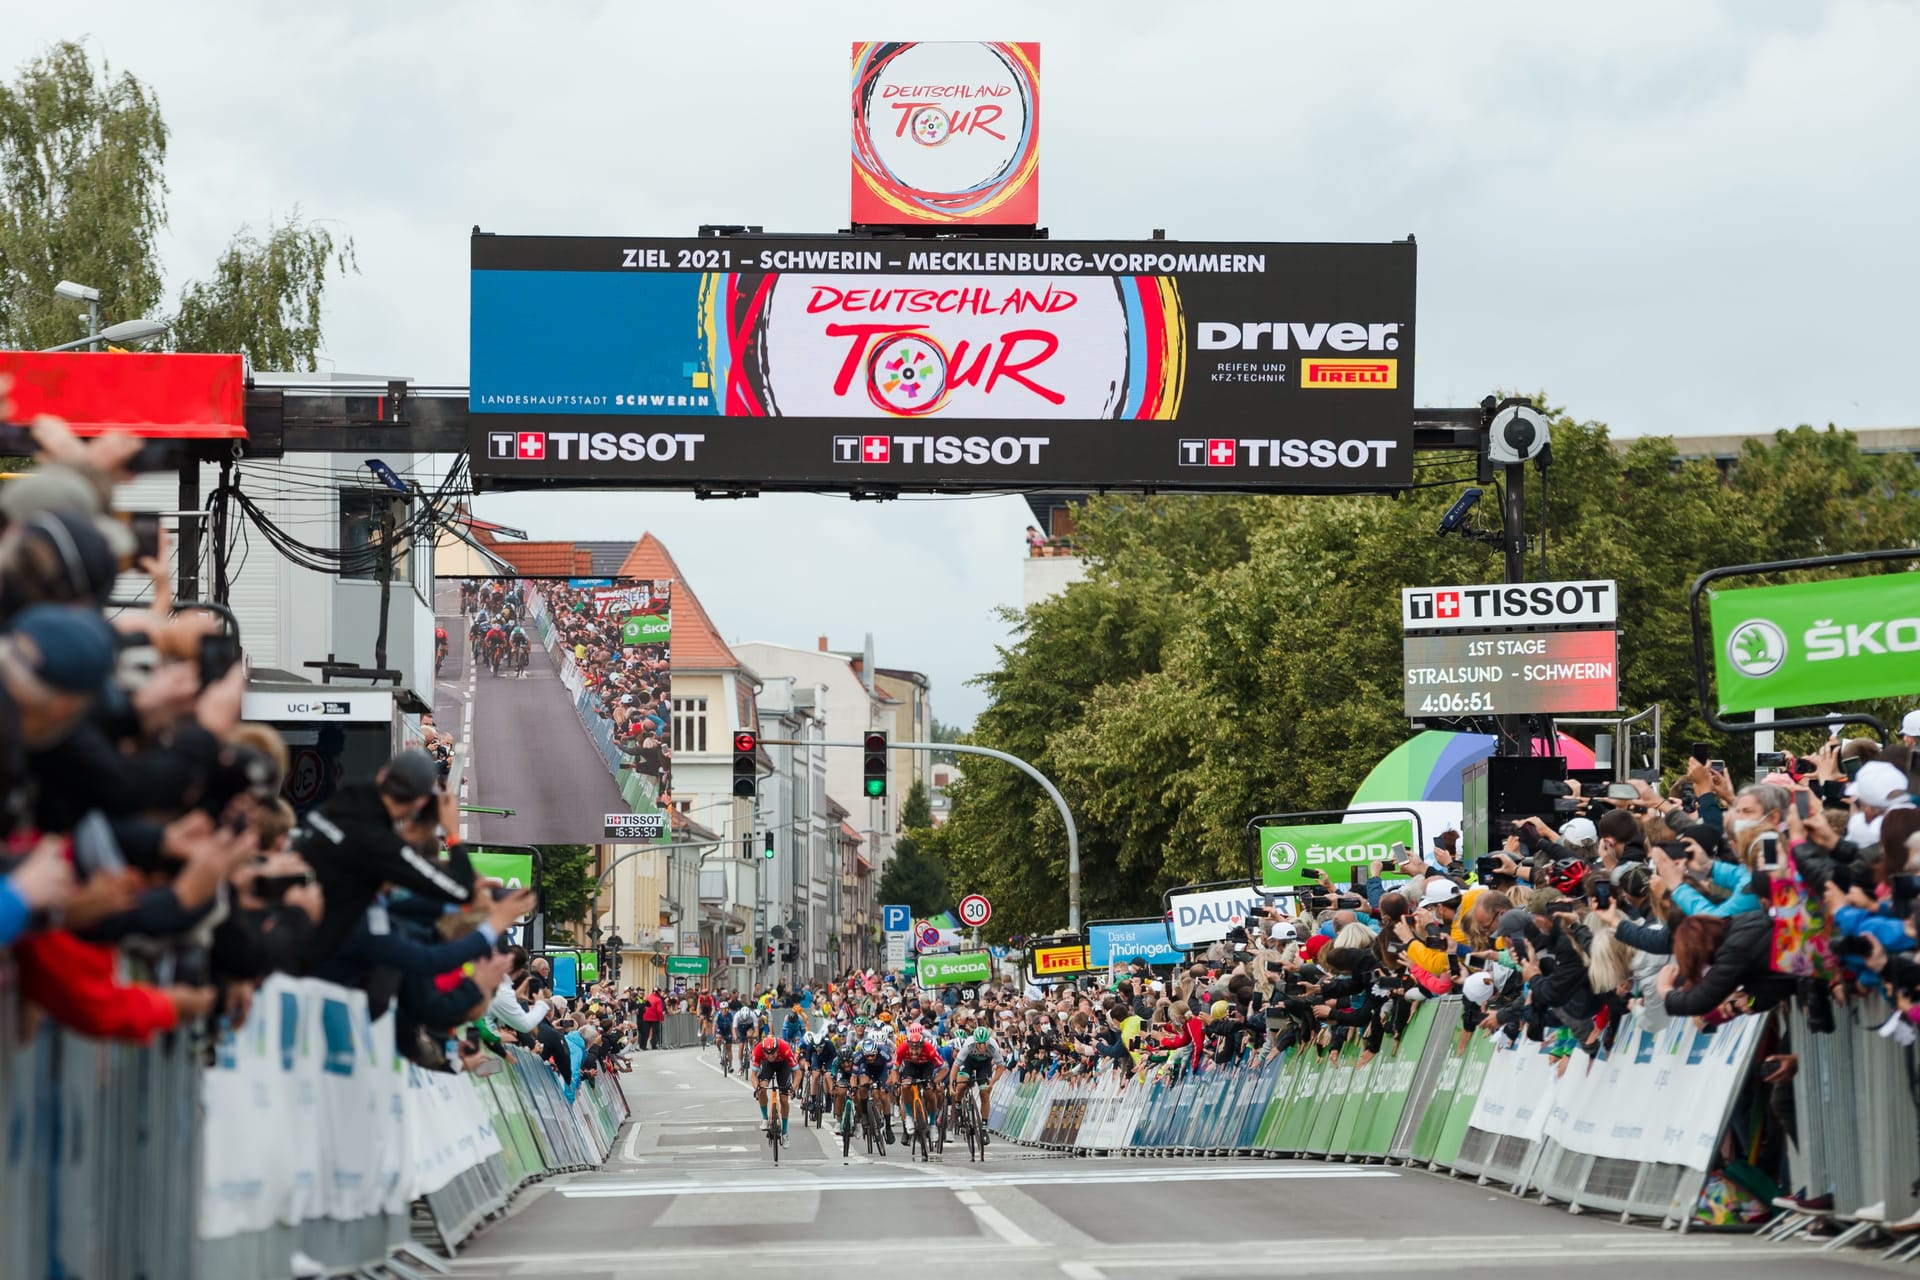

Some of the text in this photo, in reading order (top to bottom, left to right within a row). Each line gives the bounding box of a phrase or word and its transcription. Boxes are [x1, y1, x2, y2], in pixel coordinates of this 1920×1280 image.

[882, 83, 1011, 98] DEUTSCHLAND
[892, 103, 1005, 148] TOUR
[622, 249, 671, 267] ZIEL
[678, 250, 731, 268] 2021
[760, 250, 881, 270] SCHWERIN
[908, 251, 1265, 273] MECKLENBURG-VORPOMMERN
[806, 282, 1078, 315] DEUTSCHLAND
[825, 323, 1065, 416] TOUR
[1218, 363, 1286, 372] REIFEN UND
[1309, 364, 1389, 383] PIRELLI
[1211, 374, 1285, 382] KFZ-TECHNIK
[481, 395, 709, 407] LANDESHAUPTSTADT SCHWERIN
[548, 432, 705, 461] TISSOT
[893, 436, 1049, 464] TISSOT
[1239, 439, 1397, 467] TISSOT
[1464, 586, 1609, 617] TISSOT
[1468, 639, 1546, 656] 1ST STAGE
[1408, 666, 1503, 685] STRALSUND
[1524, 662, 1612, 681] SCHWERIN
[287, 704, 309, 713] UCI
[1420, 692, 1494, 712] 4:06:51
[622, 816, 661, 825] TISSOT
[1306, 843, 1393, 864] ŠKOD
[890, 909, 904, 929] P
[967, 904, 984, 917] 30
[1108, 931, 1125, 942] Das
[940, 963, 987, 975] ŠKODA
[962, 988, 975, 1000] 150
